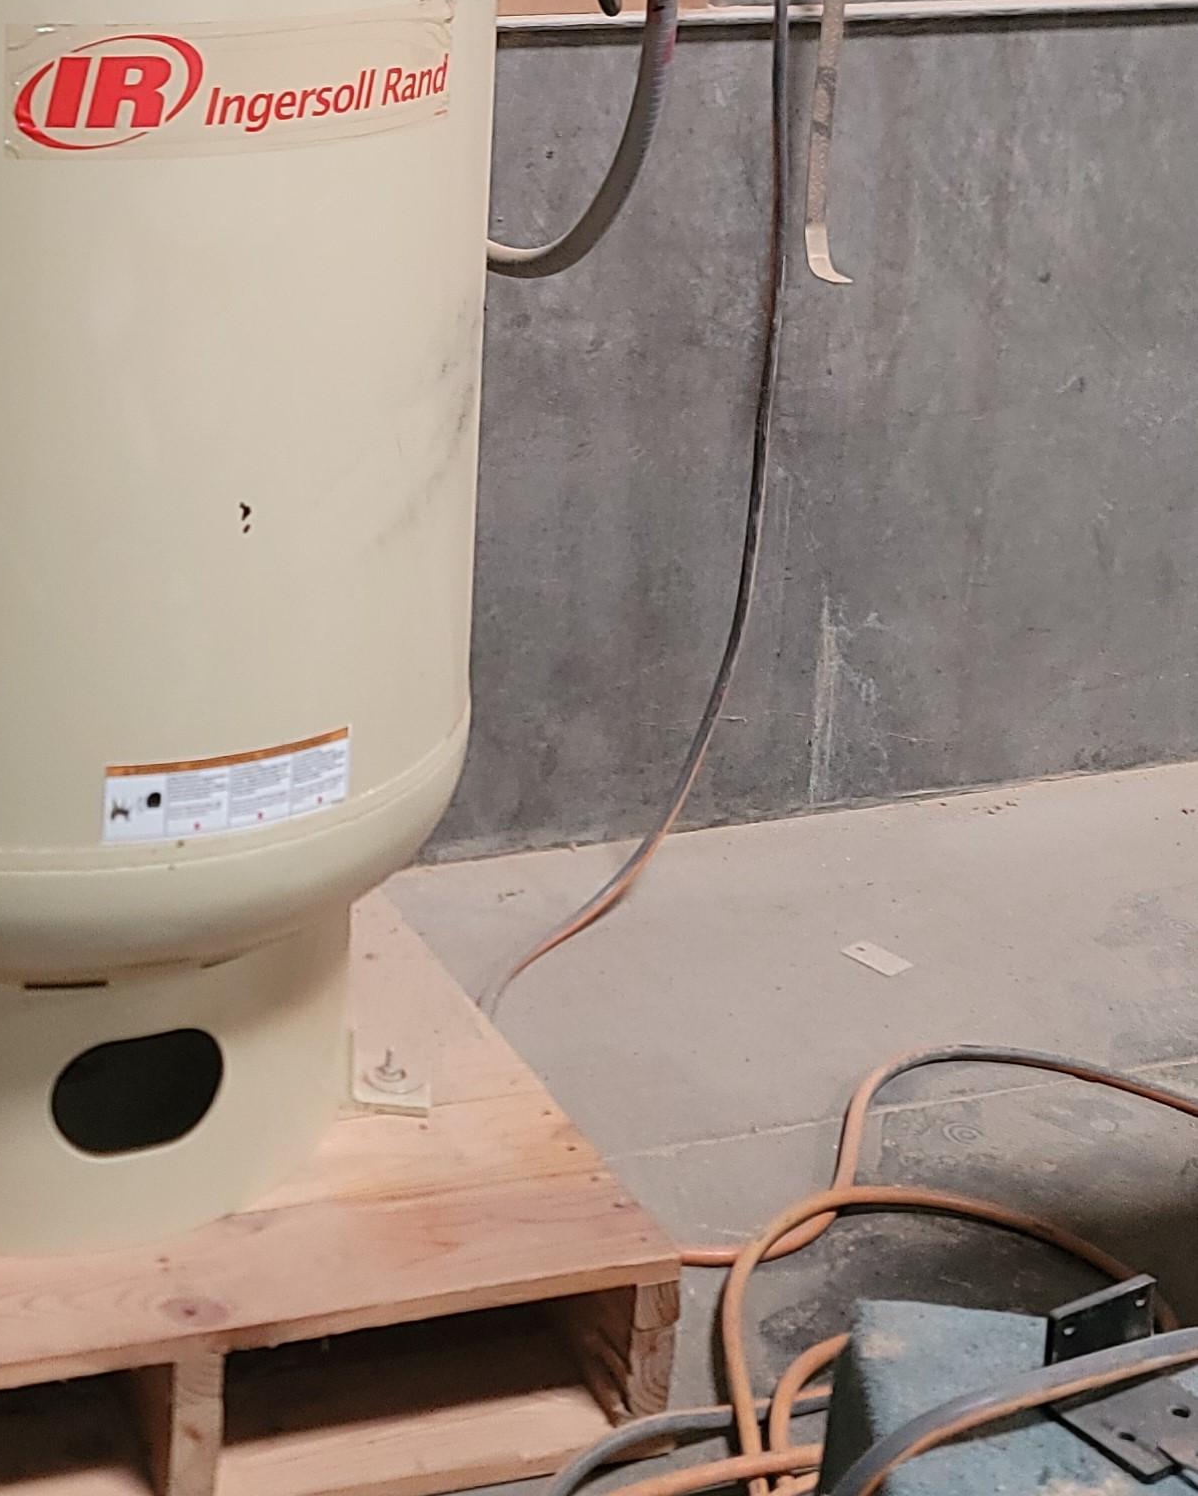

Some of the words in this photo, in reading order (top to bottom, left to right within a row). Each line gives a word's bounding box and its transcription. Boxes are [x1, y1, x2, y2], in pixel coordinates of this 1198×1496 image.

[45, 56, 172, 129] IR
[204, 68, 377, 133] Ingersoll
[381, 52, 450, 106] Rand
